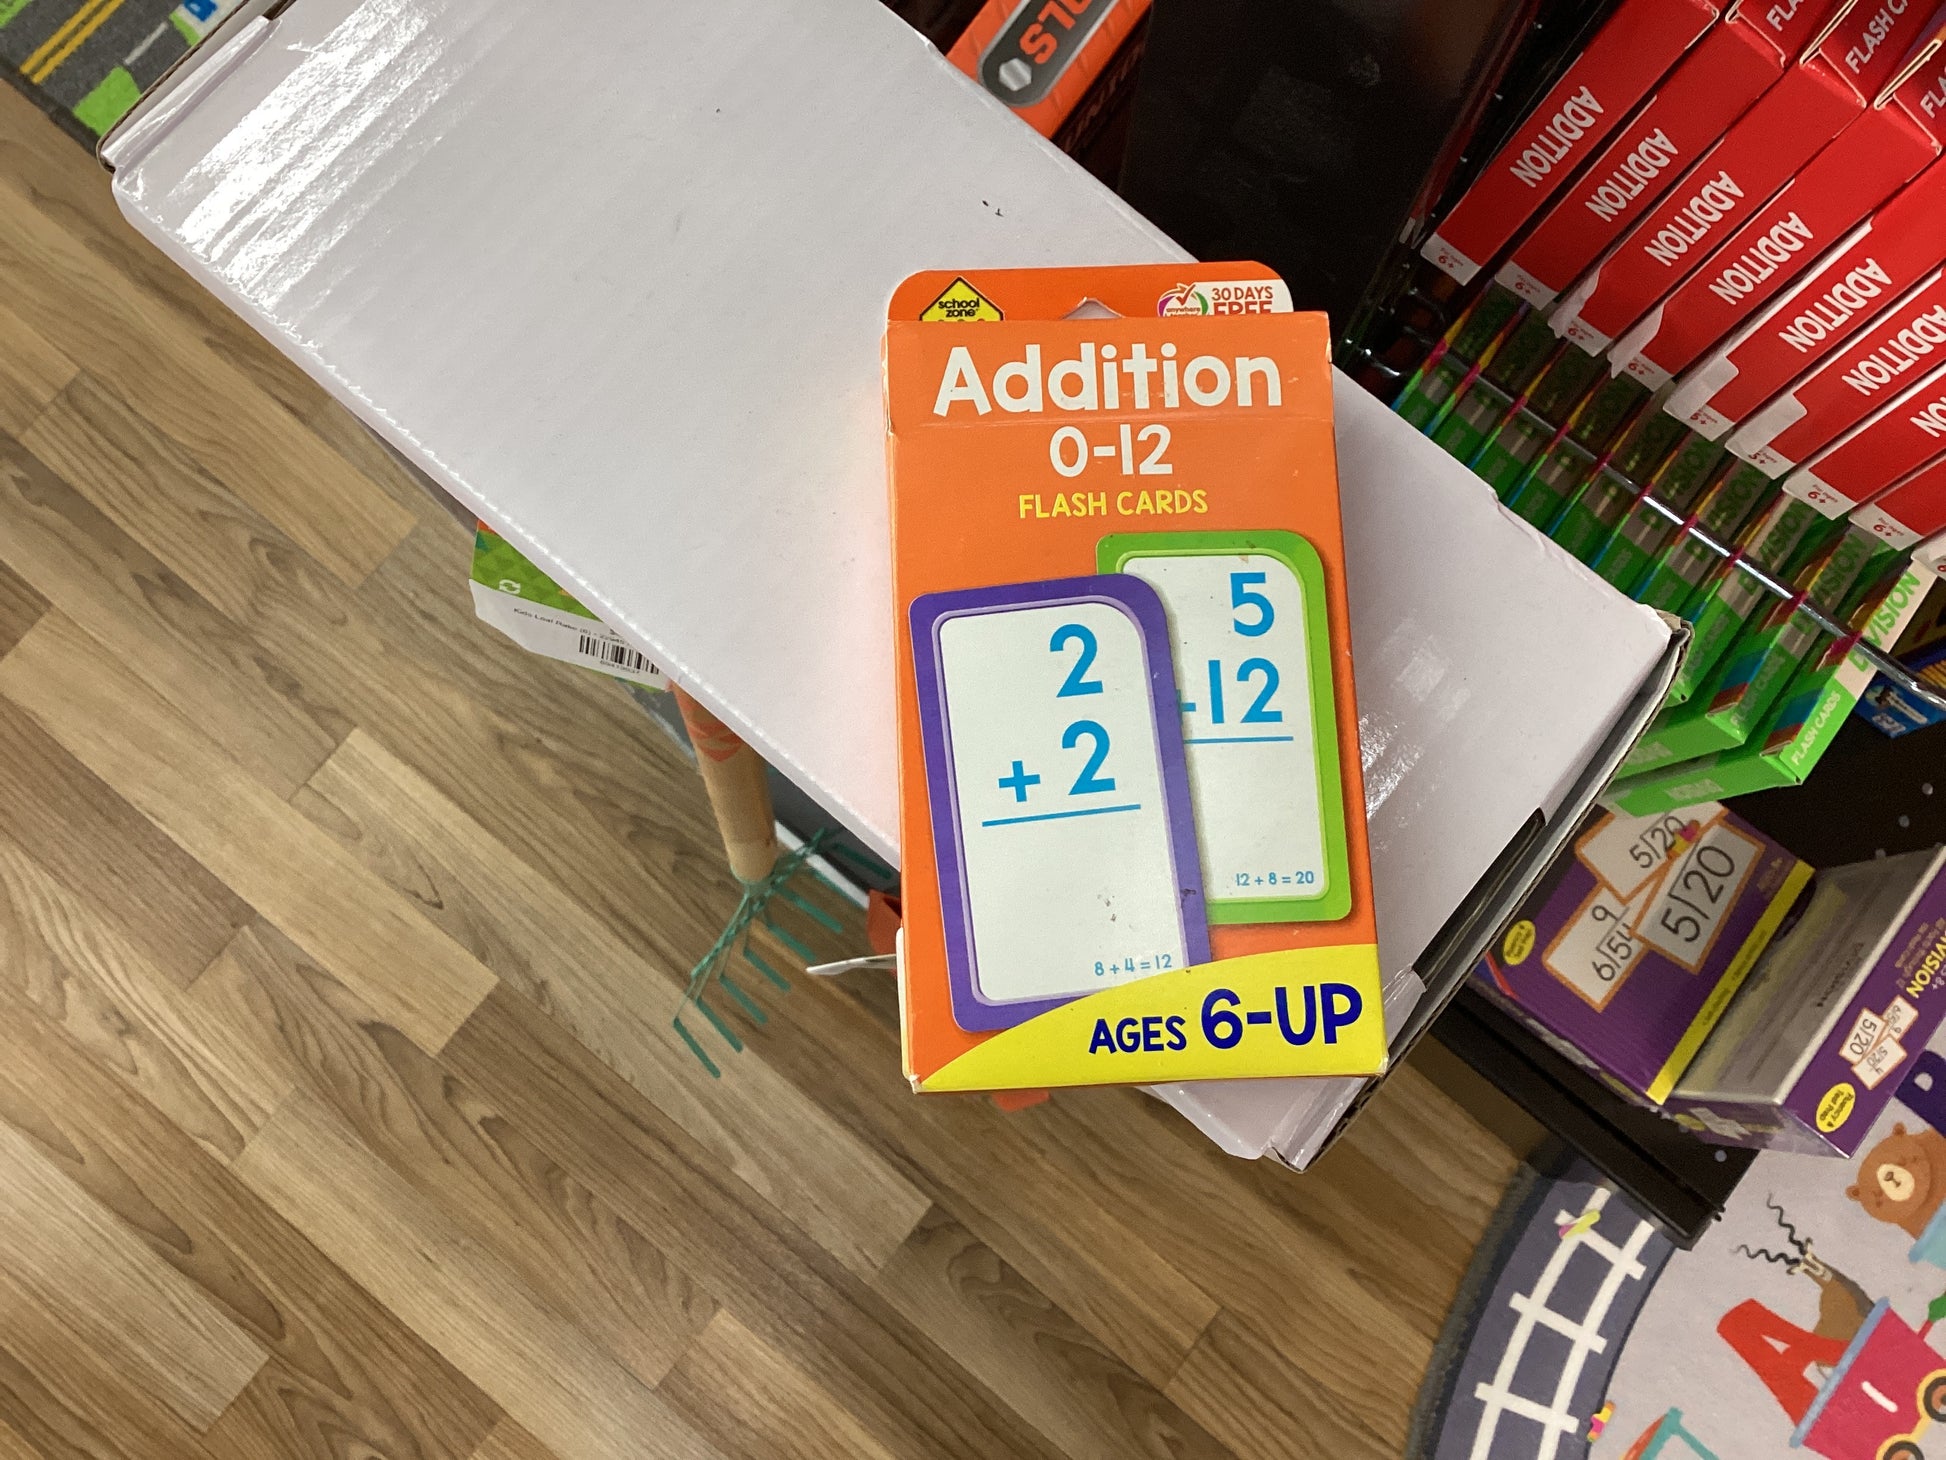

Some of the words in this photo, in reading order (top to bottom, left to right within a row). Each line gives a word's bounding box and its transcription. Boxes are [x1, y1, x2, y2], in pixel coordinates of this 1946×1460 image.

[1845, 8, 1895, 74] FLASH
[1509, 85, 1604, 188] ADDITION
[1585, 127, 1679, 223] ADDITION
[1644, 171, 1746, 267] ADDITION
[1211, 287, 1231, 301] 30
[1235, 286, 1273, 300] DAYS
[1708, 211, 1815, 305] ADDITION
[938, 298, 980, 309] school
[946, 309, 976, 318] zone
[1166, 306, 1201, 314] anywhere
[1778, 258, 1893, 353] ADDITION
[933, 342, 1282, 416] Addition
[1842, 304, 1946, 396] ADDITION
[1050, 424, 1173, 477] 0-12
[1019, 491, 1108, 519] FLASH
[1116, 489, 1208, 515] CARDS
[1230, 572, 1275, 637] 5
[1792, 533, 1866, 635] DVISION
[1848, 571, 1921, 672] DVISION
[1049, 623, 1104, 699] 2
[1208, 658, 1283, 725] 12
[998, 760, 1041, 803] +
[1061, 719, 1117, 796] 2
[1791, 725, 1818, 765] FLASH
[1815, 692, 1841, 729] CARDS
[1235, 873, 1250, 887] 12
[1268, 872, 1277, 886] 8
[1296, 871, 1315, 886] 20
[1094, 961, 1106, 977] 8
[1154, 954, 1173, 971] 12
[1088, 1014, 1188, 1055] AGES
[1200, 981, 1363, 1050] 6-UP
[1831, 1092, 1854, 1121] Fluency
